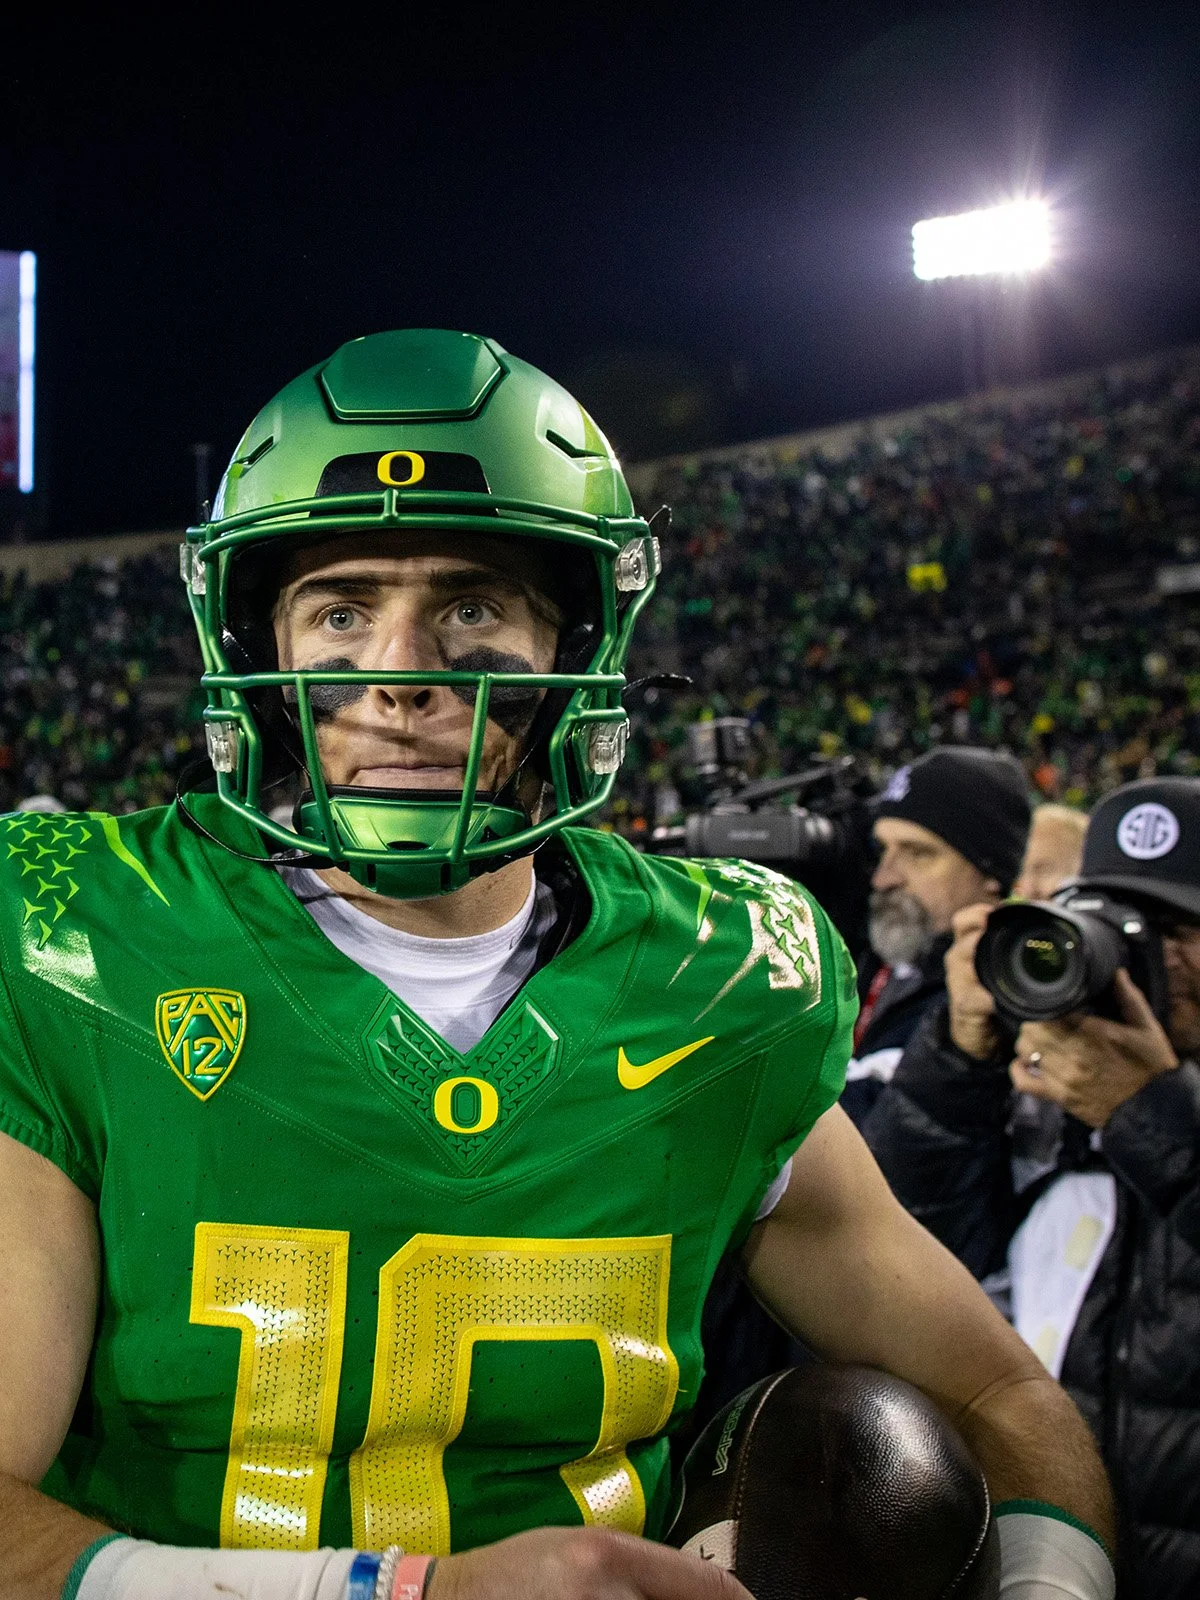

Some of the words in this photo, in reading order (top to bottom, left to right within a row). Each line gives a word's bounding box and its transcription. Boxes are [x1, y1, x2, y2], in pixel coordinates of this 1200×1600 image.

[377, 450, 426, 486] O
[161, 993, 240, 1056] PAC
[182, 1036, 225, 1076] 12
[433, 1076, 499, 1134] O
[189, 1222, 680, 1556] 10
